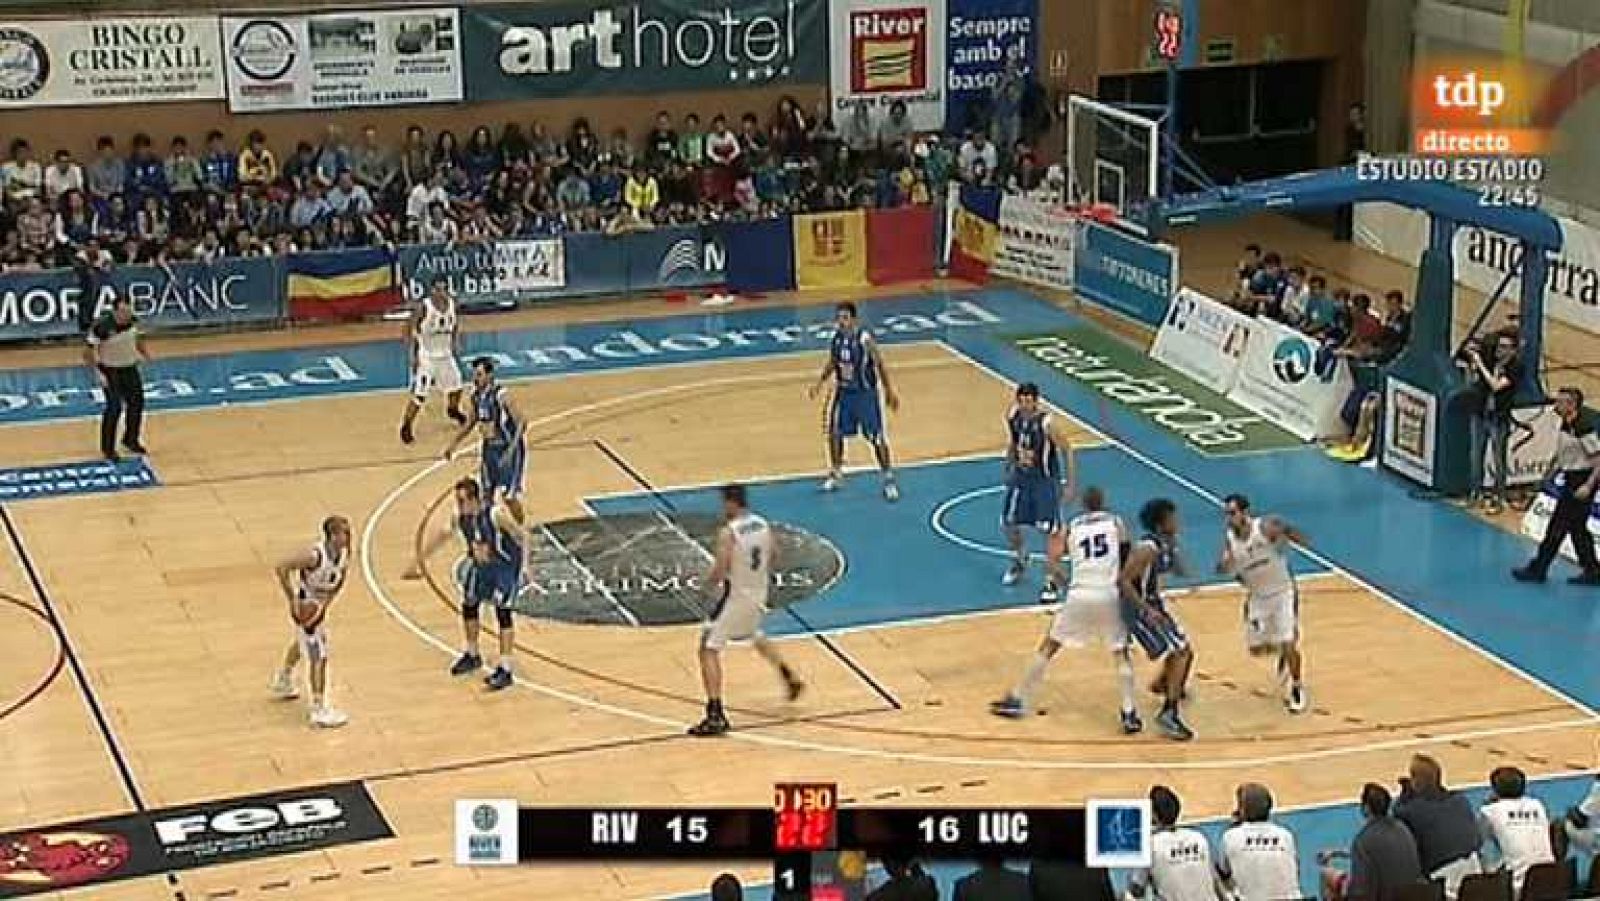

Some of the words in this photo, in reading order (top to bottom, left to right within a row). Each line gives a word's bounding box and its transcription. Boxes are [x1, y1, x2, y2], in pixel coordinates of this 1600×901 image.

[92, 24, 185, 46] BINGO
[853, 15, 923, 37] River
[949, 16, 1030, 39] Sempre
[69, 46, 211, 70] CRISTALL
[953, 38, 1001, 63] amb
[414, 251, 467, 281] Amb
[1079, 534, 1109, 559] 15
